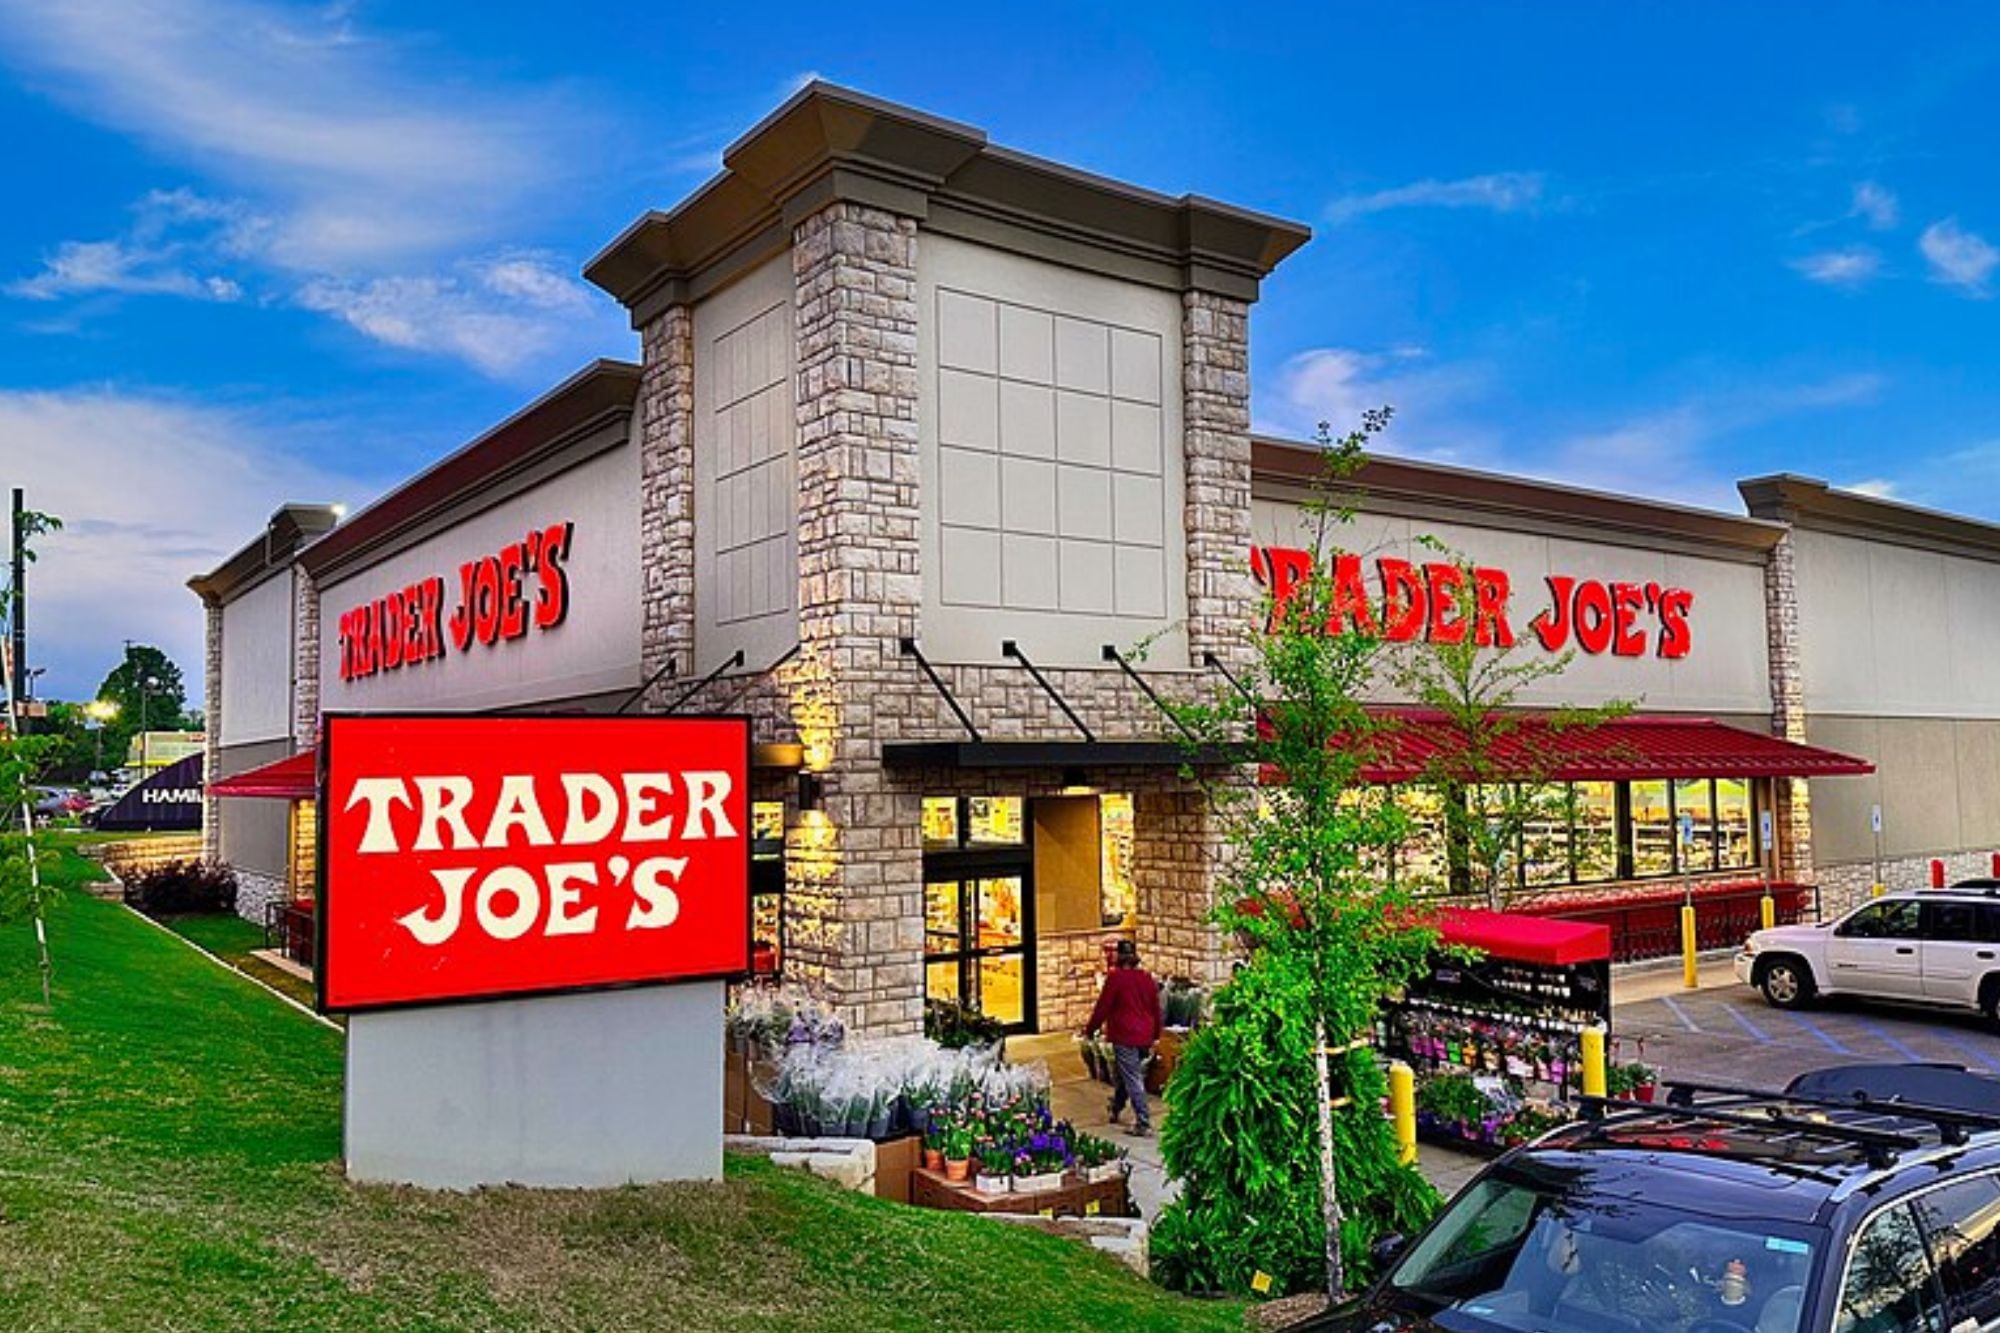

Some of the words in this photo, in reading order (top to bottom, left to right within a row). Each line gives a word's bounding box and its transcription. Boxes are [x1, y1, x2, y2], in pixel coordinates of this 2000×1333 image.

[339, 577, 444, 681] TRADER
[449, 523, 573, 654] JOE'S
[1250, 545, 1515, 648] RADER
[1529, 576, 1695, 659] JOE'S
[344, 771, 738, 853] TRADER
[396, 856, 690, 945] JOE'S
